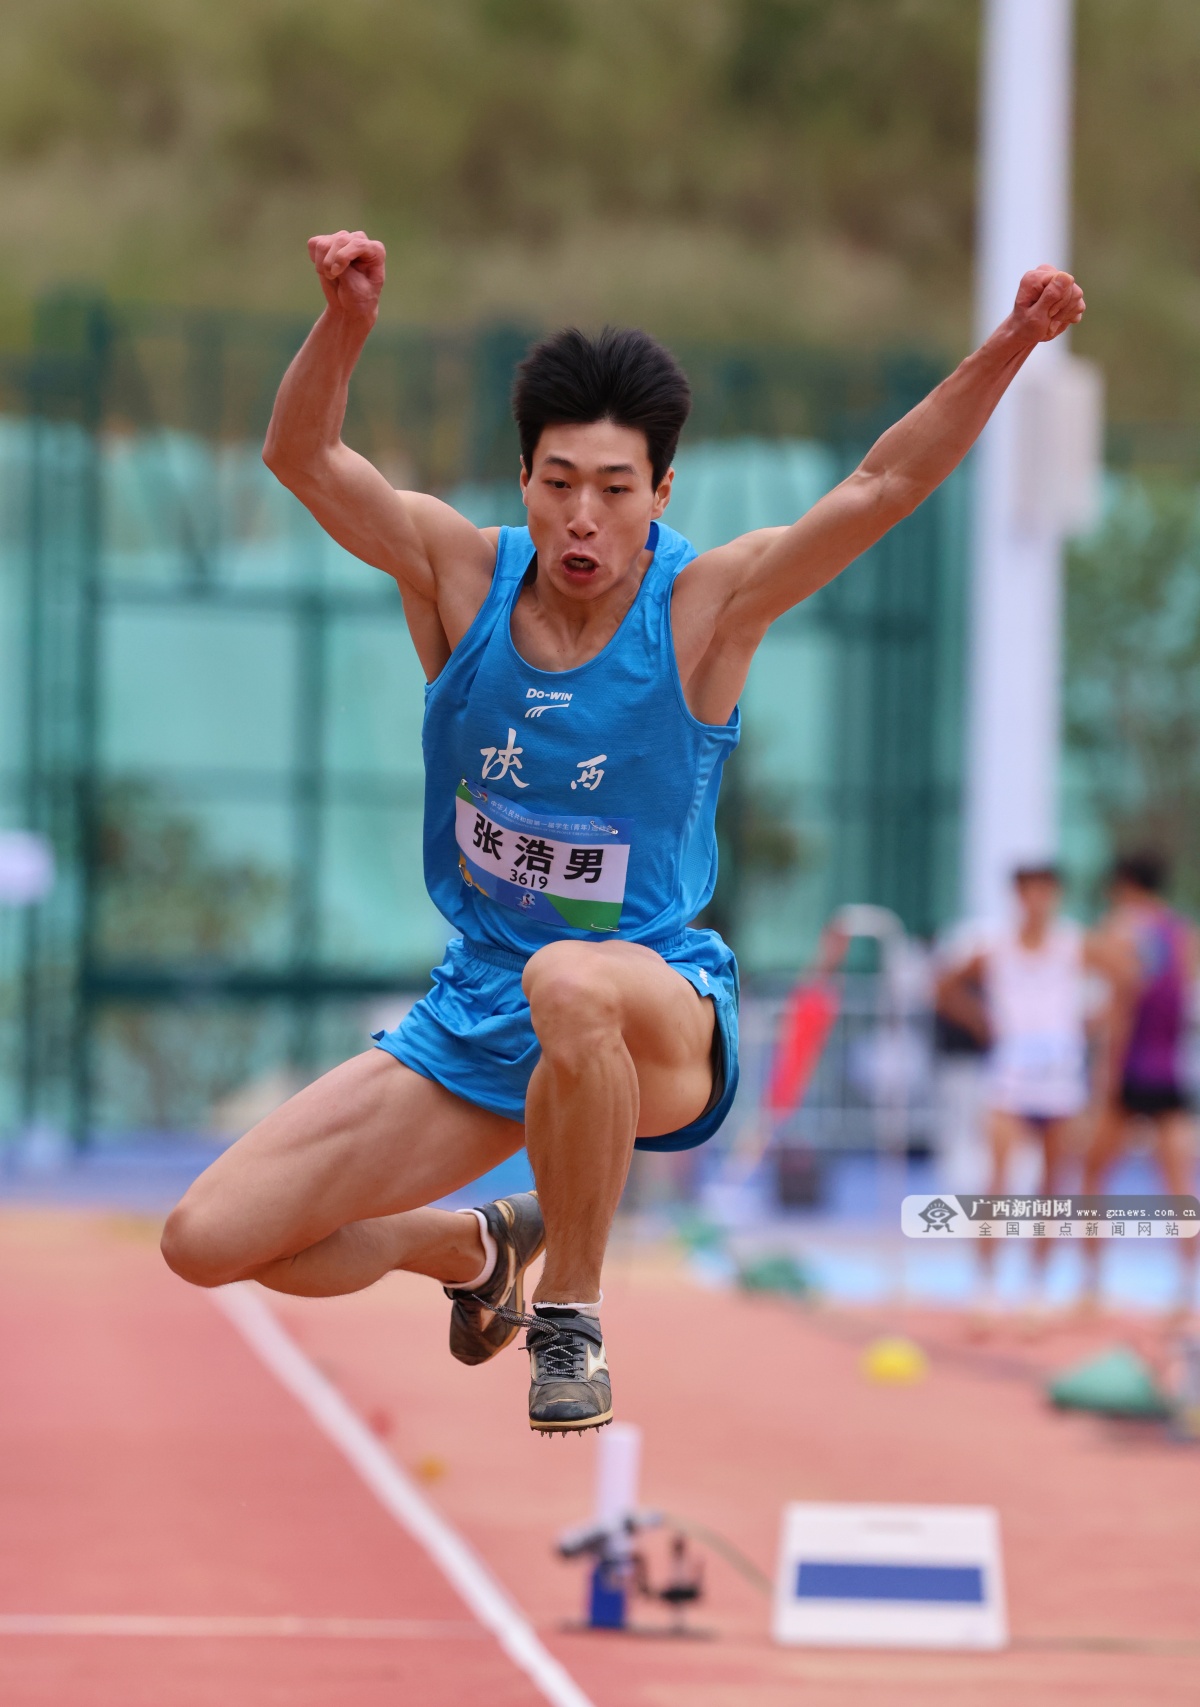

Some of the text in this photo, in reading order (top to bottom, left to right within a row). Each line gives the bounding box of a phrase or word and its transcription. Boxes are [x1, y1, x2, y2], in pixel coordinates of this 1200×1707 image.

[480, 727, 607, 791] 陕西
[473, 812, 604, 883] 张浩男
[509, 868, 548, 890] 3619
